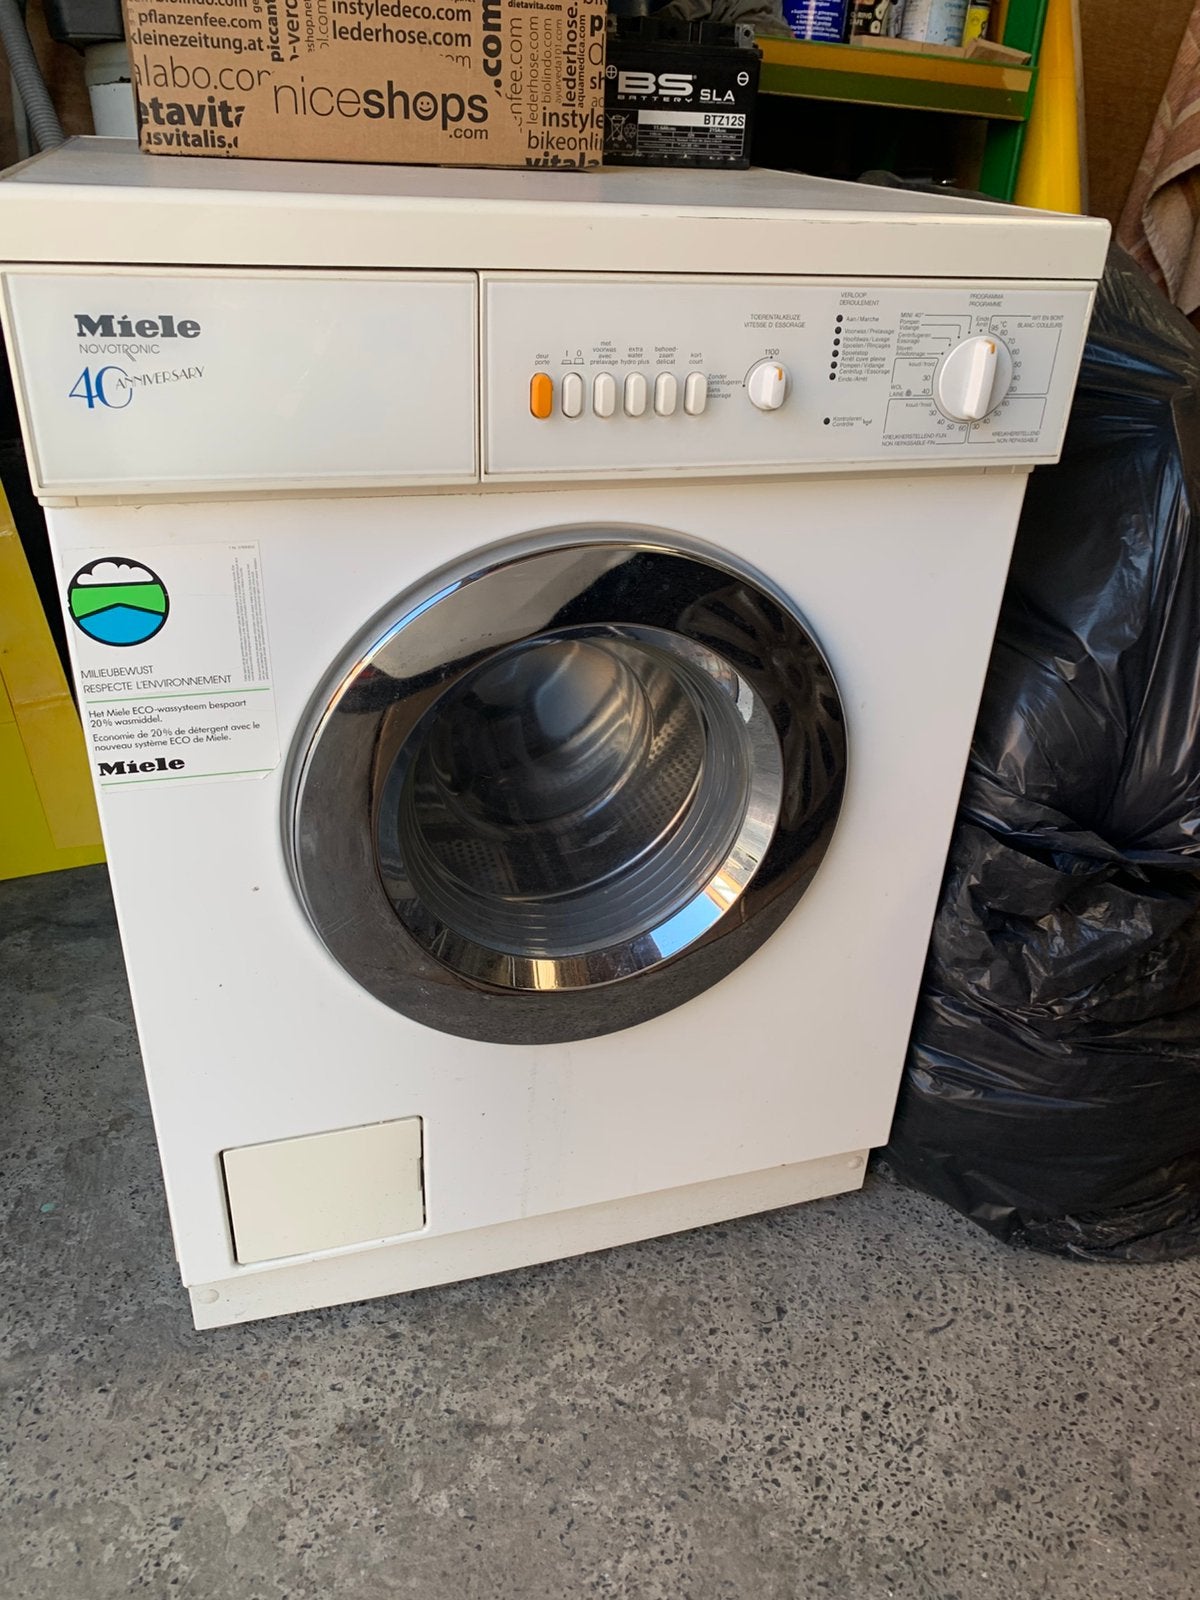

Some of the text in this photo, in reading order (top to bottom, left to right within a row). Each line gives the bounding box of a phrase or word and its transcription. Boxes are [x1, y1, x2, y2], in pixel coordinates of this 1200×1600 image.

[138, 9, 262, 29] pflanzenfee.com
[130, 28, 264, 54] kleinezeitung.at
[332, 20, 471, 48] lederhose.com
[482, 0, 502, 97] .com
[526, 15, 539, 124] lederhose.com
[542, 17, 552, 103] biolindo.com
[506, 16, 523, 133] nfee.com
[618, 71, 693, 96] BS
[273, 75, 489, 131] niceshops
[617, 95, 693, 103] BATTERY
[700, 89, 735, 102] SLA
[704, 115, 744, 127] BTZ12S
[449, 128, 489, 139] .com
[74, 314, 201, 338] Miele
[79, 344, 161, 361] NOVOTRONIC
[765, 348, 780, 356] 1100
[620, 359, 637, 367] hydro
[69, 366, 206, 409] 40 ANNIVERSARY
[80, 665, 154, 680] MILIEUBEWUST
[83, 674, 232, 694] RESPECTE L'ENVIRONNEMENT
[88, 699, 247, 719] Het Miele ECO-wassysteem bespaart
[90, 714, 163, 728] 20% wasmiddel.
[92, 720, 261, 743] Economie de 20% de détergent avec le
[94, 733, 232, 752] nouveau système ECO de Miele.
[97, 757, 185, 776] Miele
